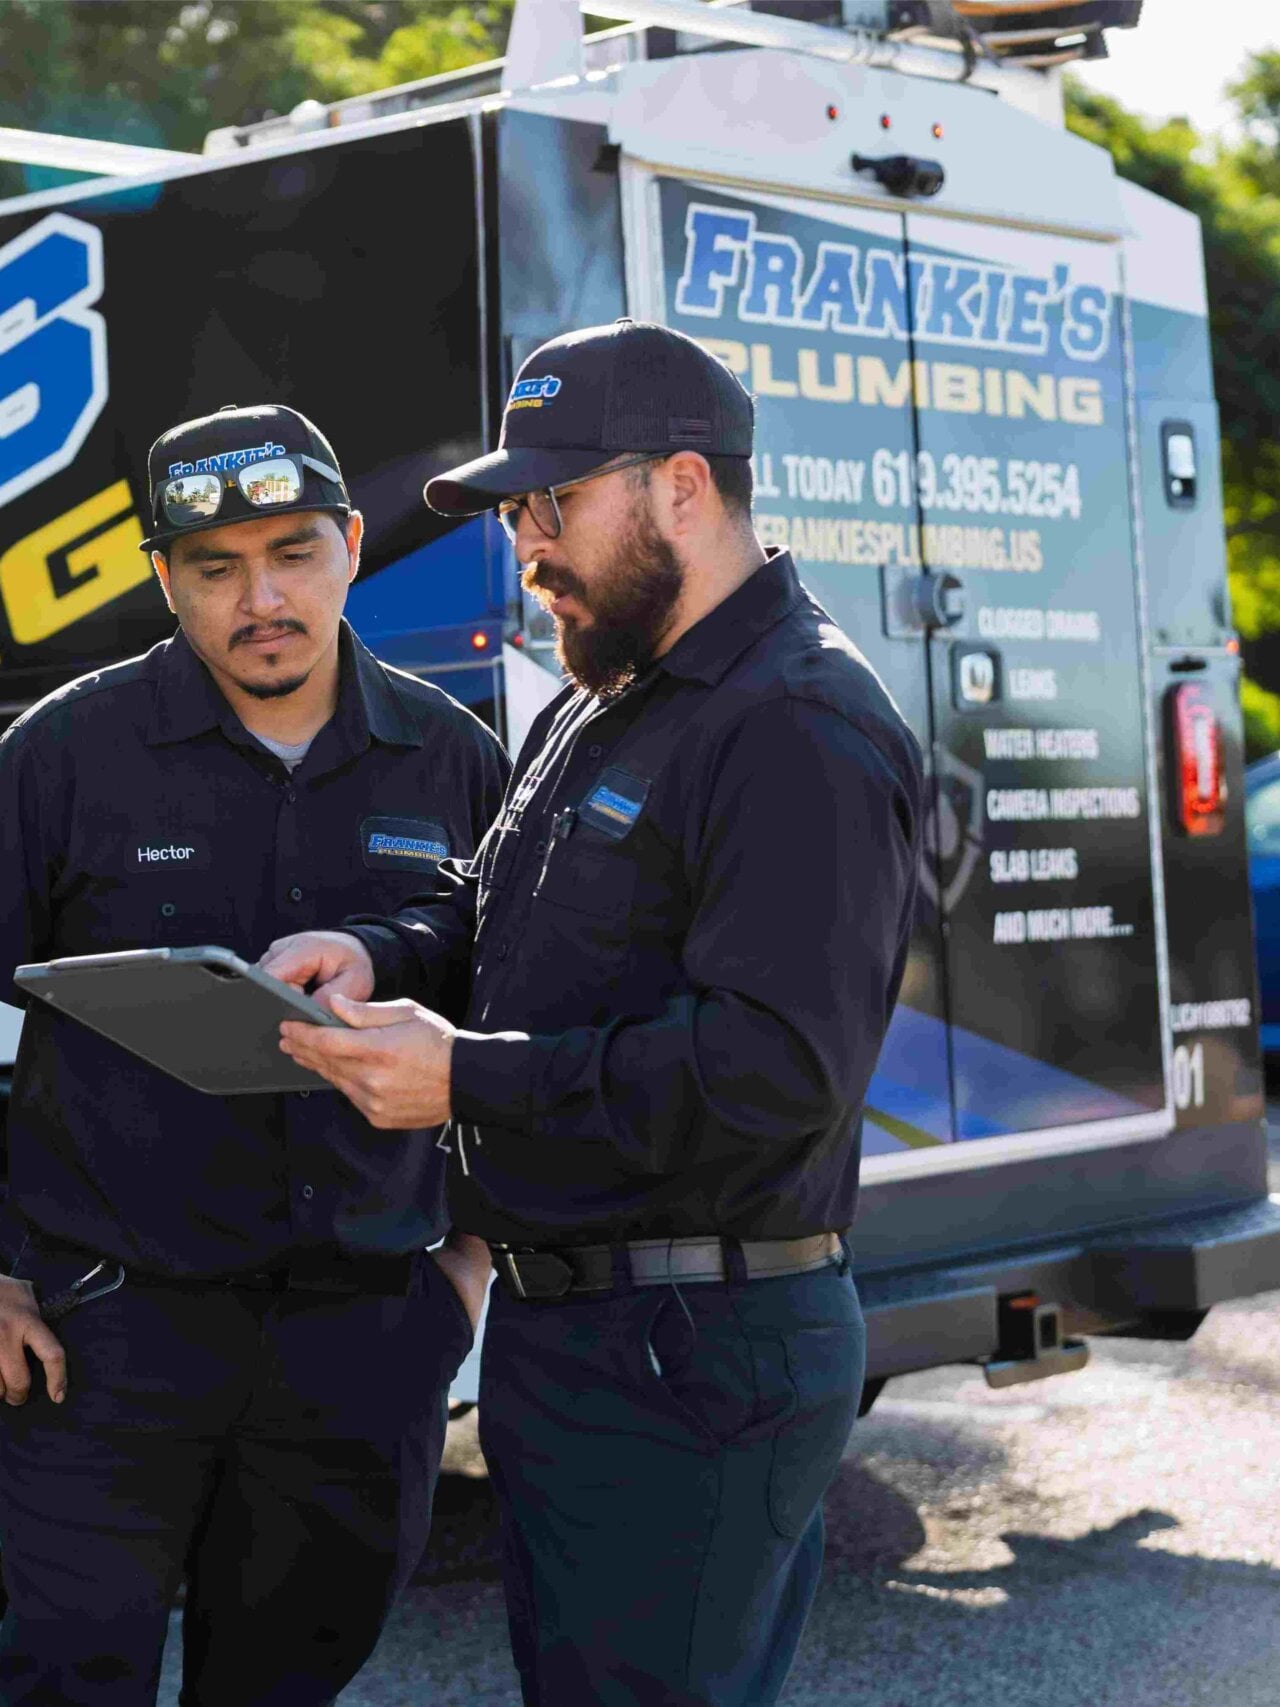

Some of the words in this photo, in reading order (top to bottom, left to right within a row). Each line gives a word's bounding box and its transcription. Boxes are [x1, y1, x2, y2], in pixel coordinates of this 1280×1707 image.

[675, 202, 1111, 362] FRANKIE'S
[782, 454, 865, 503] TODAY
[872, 448, 1081, 520] 619.395.5254
[137, 845, 195, 863] Hector
[1173, 1043, 1204, 1109] 01
